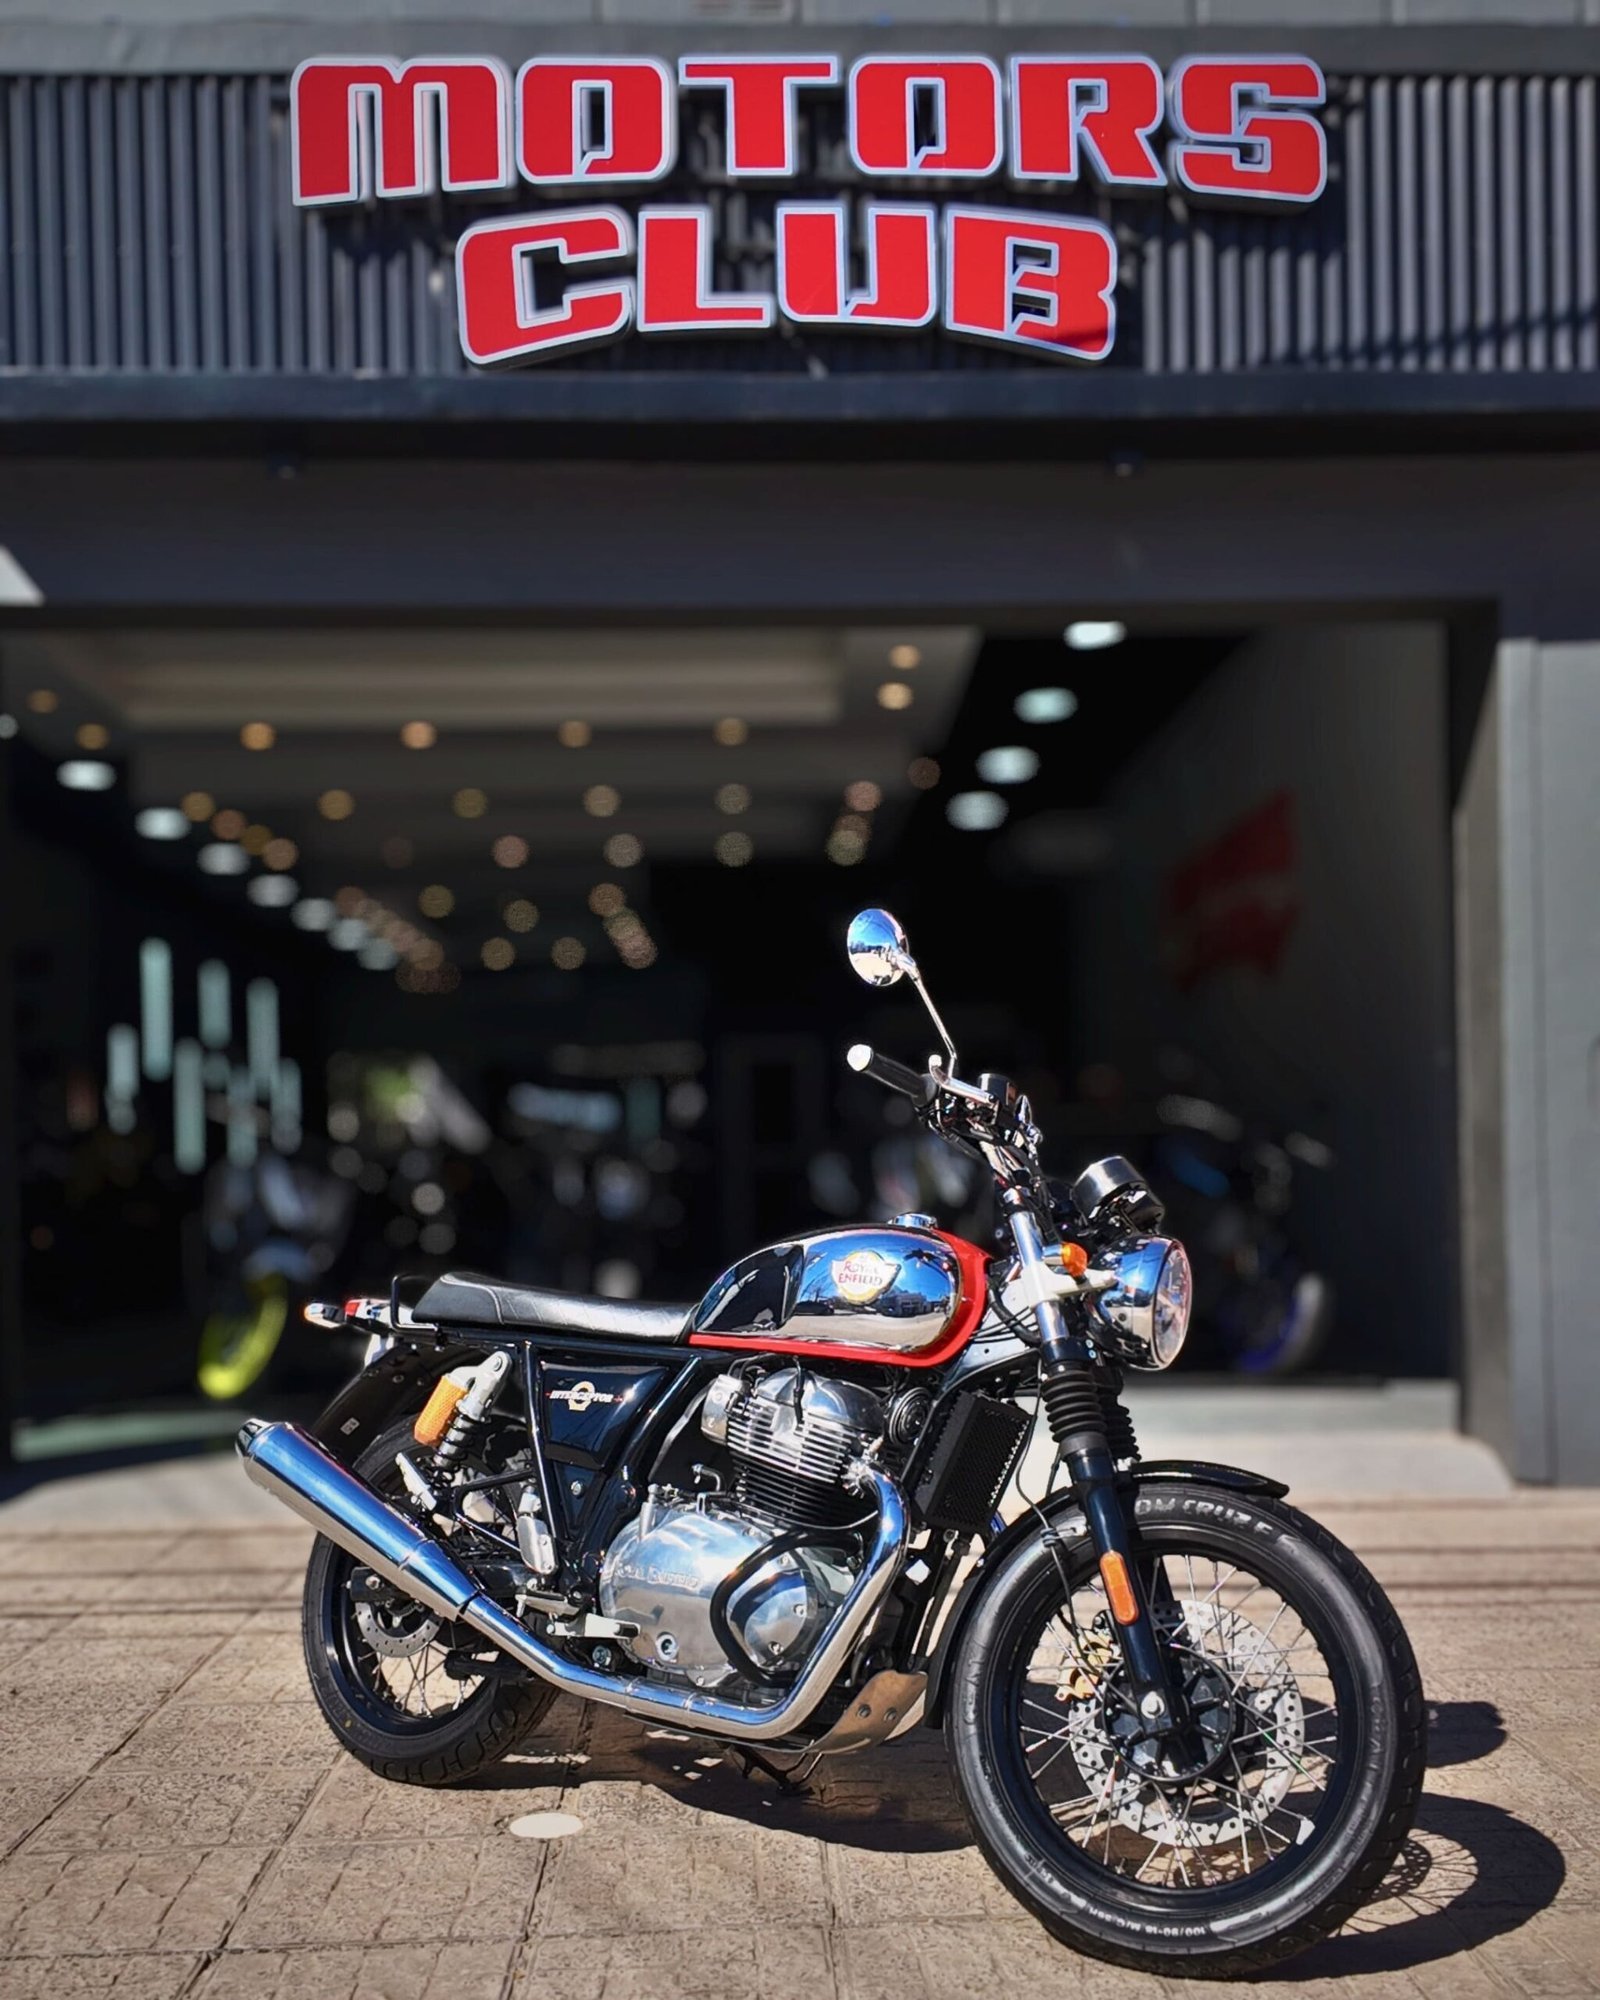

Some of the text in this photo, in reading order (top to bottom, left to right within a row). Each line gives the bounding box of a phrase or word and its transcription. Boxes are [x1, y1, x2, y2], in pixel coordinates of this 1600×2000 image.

[290, 54, 1328, 206] MOTORS
[455, 202, 1118, 365] CLUB
[838, 1272, 882, 1285] ENFIELD
